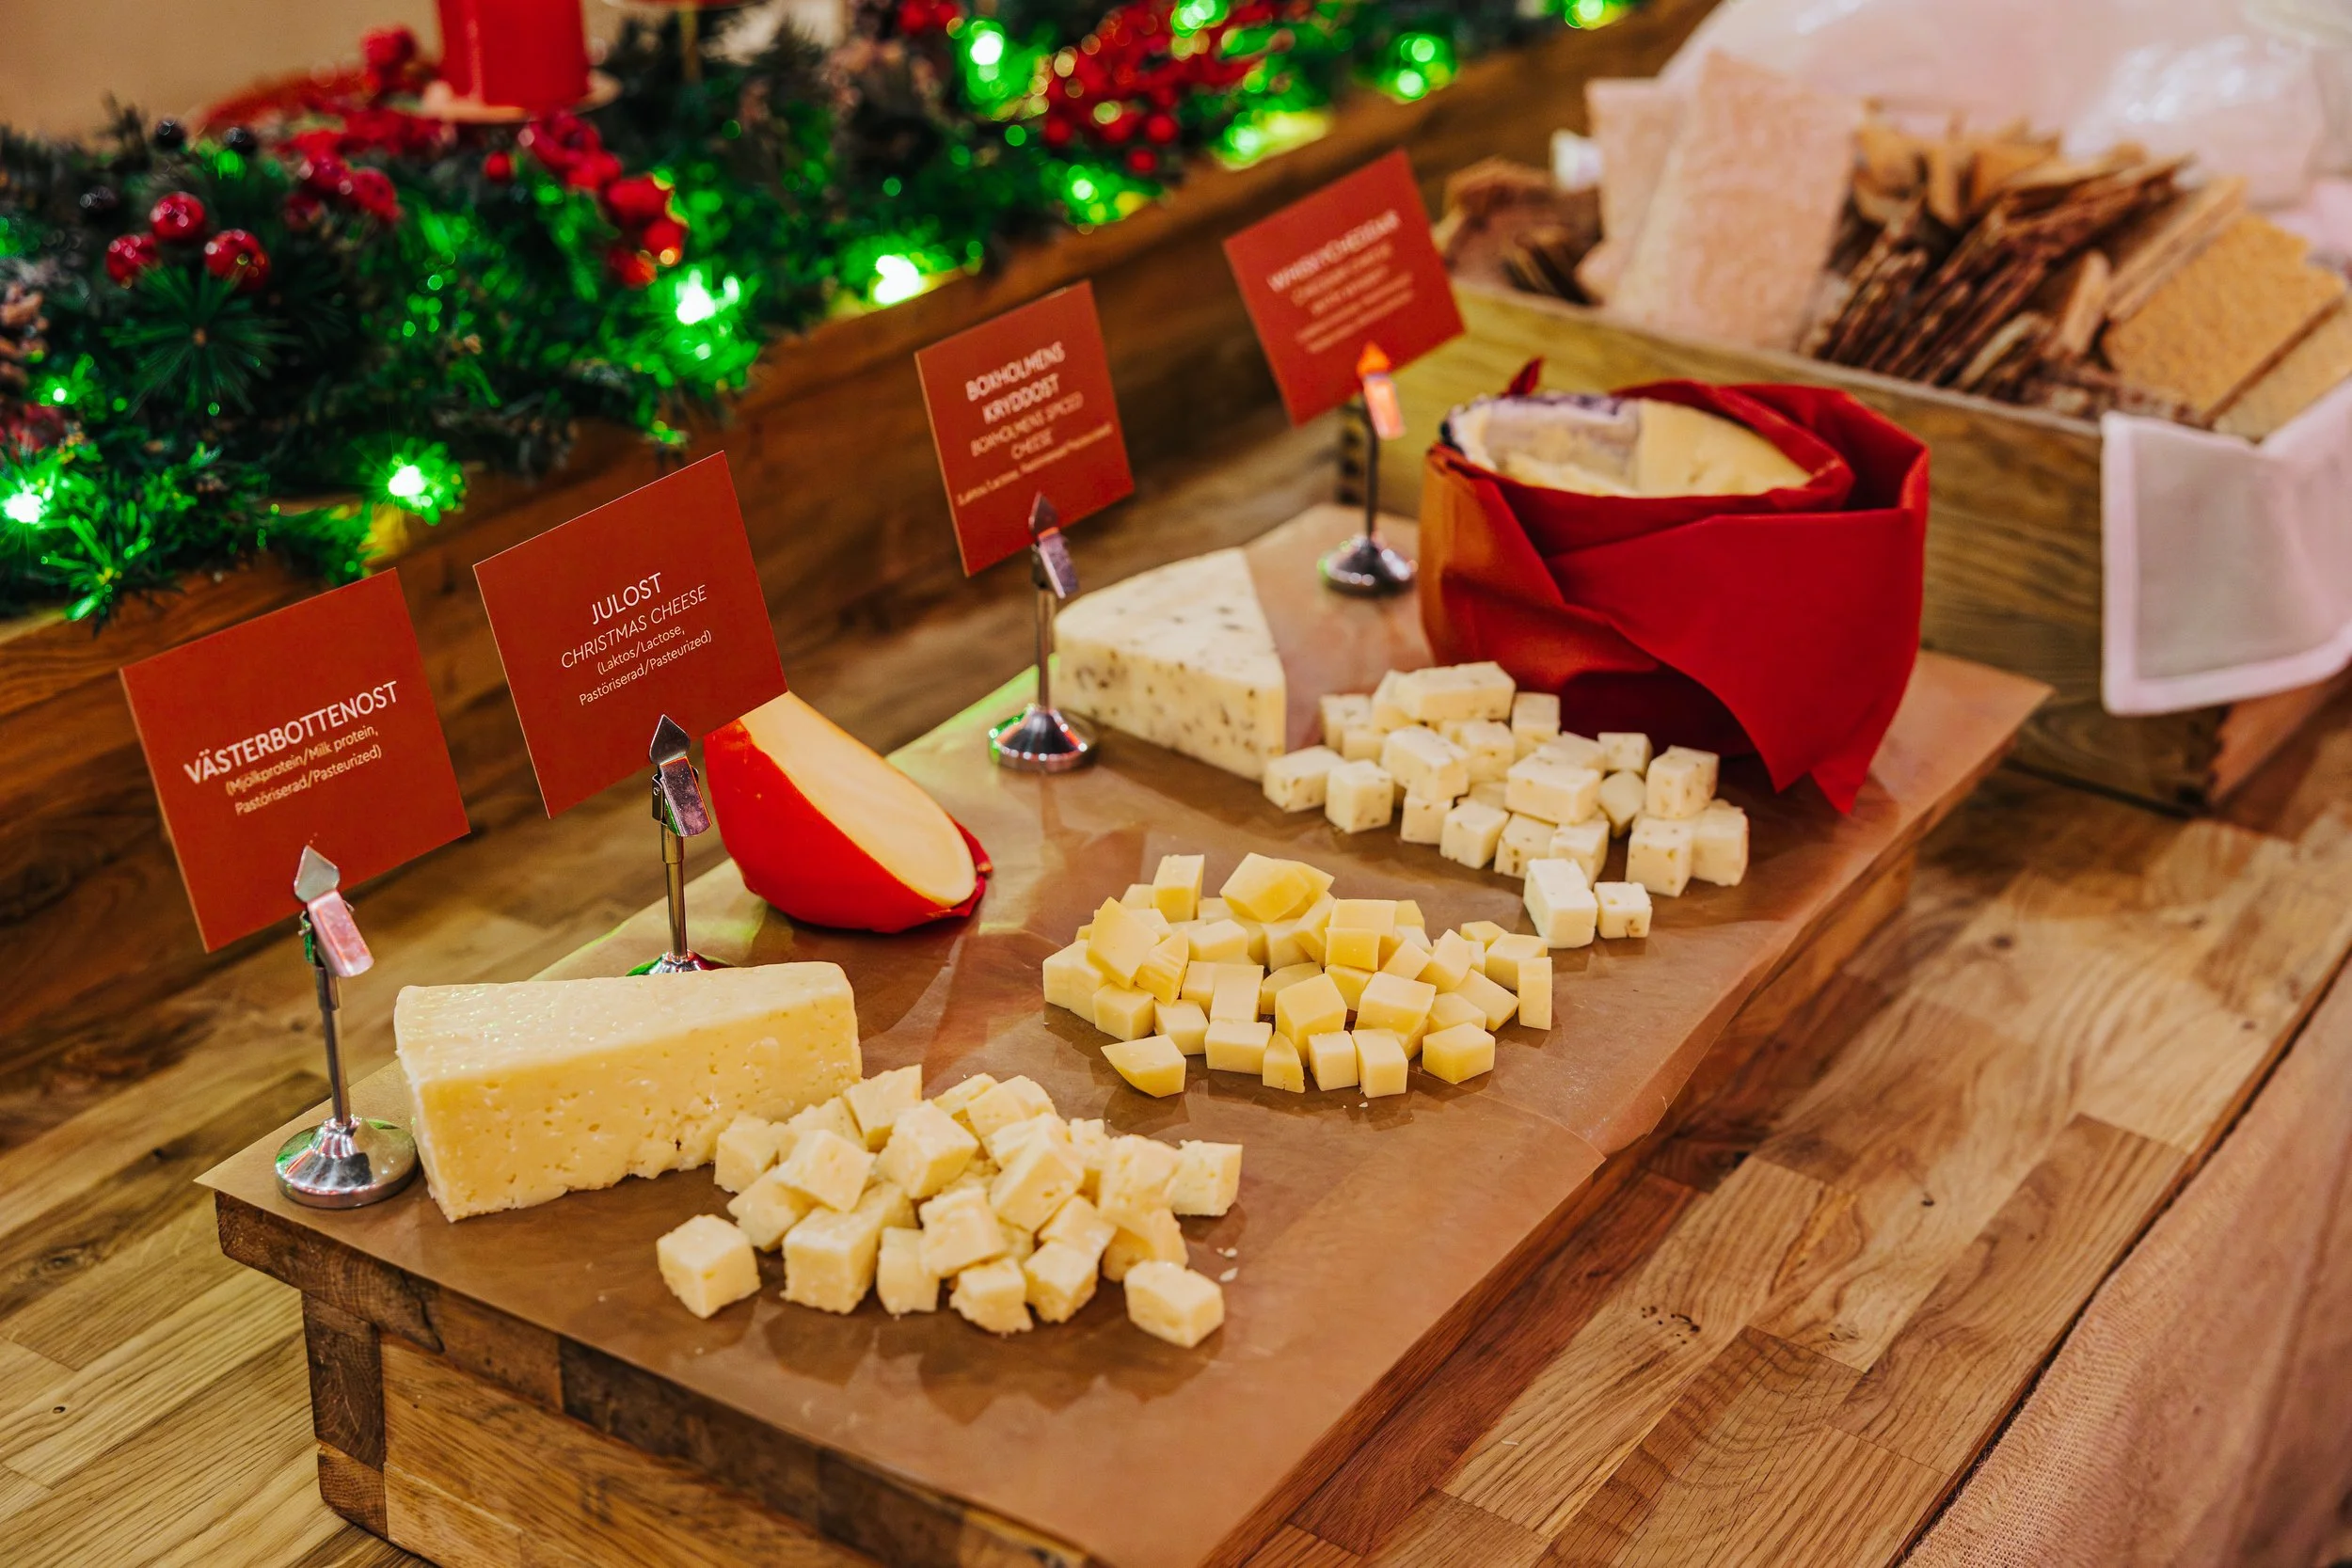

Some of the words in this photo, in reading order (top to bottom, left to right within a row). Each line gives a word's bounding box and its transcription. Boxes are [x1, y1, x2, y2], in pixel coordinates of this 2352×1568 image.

[561, 614, 647, 669] CHRISTMAS
[650, 584, 707, 624] CHEESE
[592, 572, 661, 626] JULOST
[579, 629, 712, 706] Pastöriserad/Pasteurized)
[597, 625, 685, 675] (Laktos/Lactose,
[183, 680, 397, 784] VÄSTERBOTTENOST
[334, 724, 379, 755] protein,
[235, 744, 383, 816] Pastöriserad/Pasteurized)
